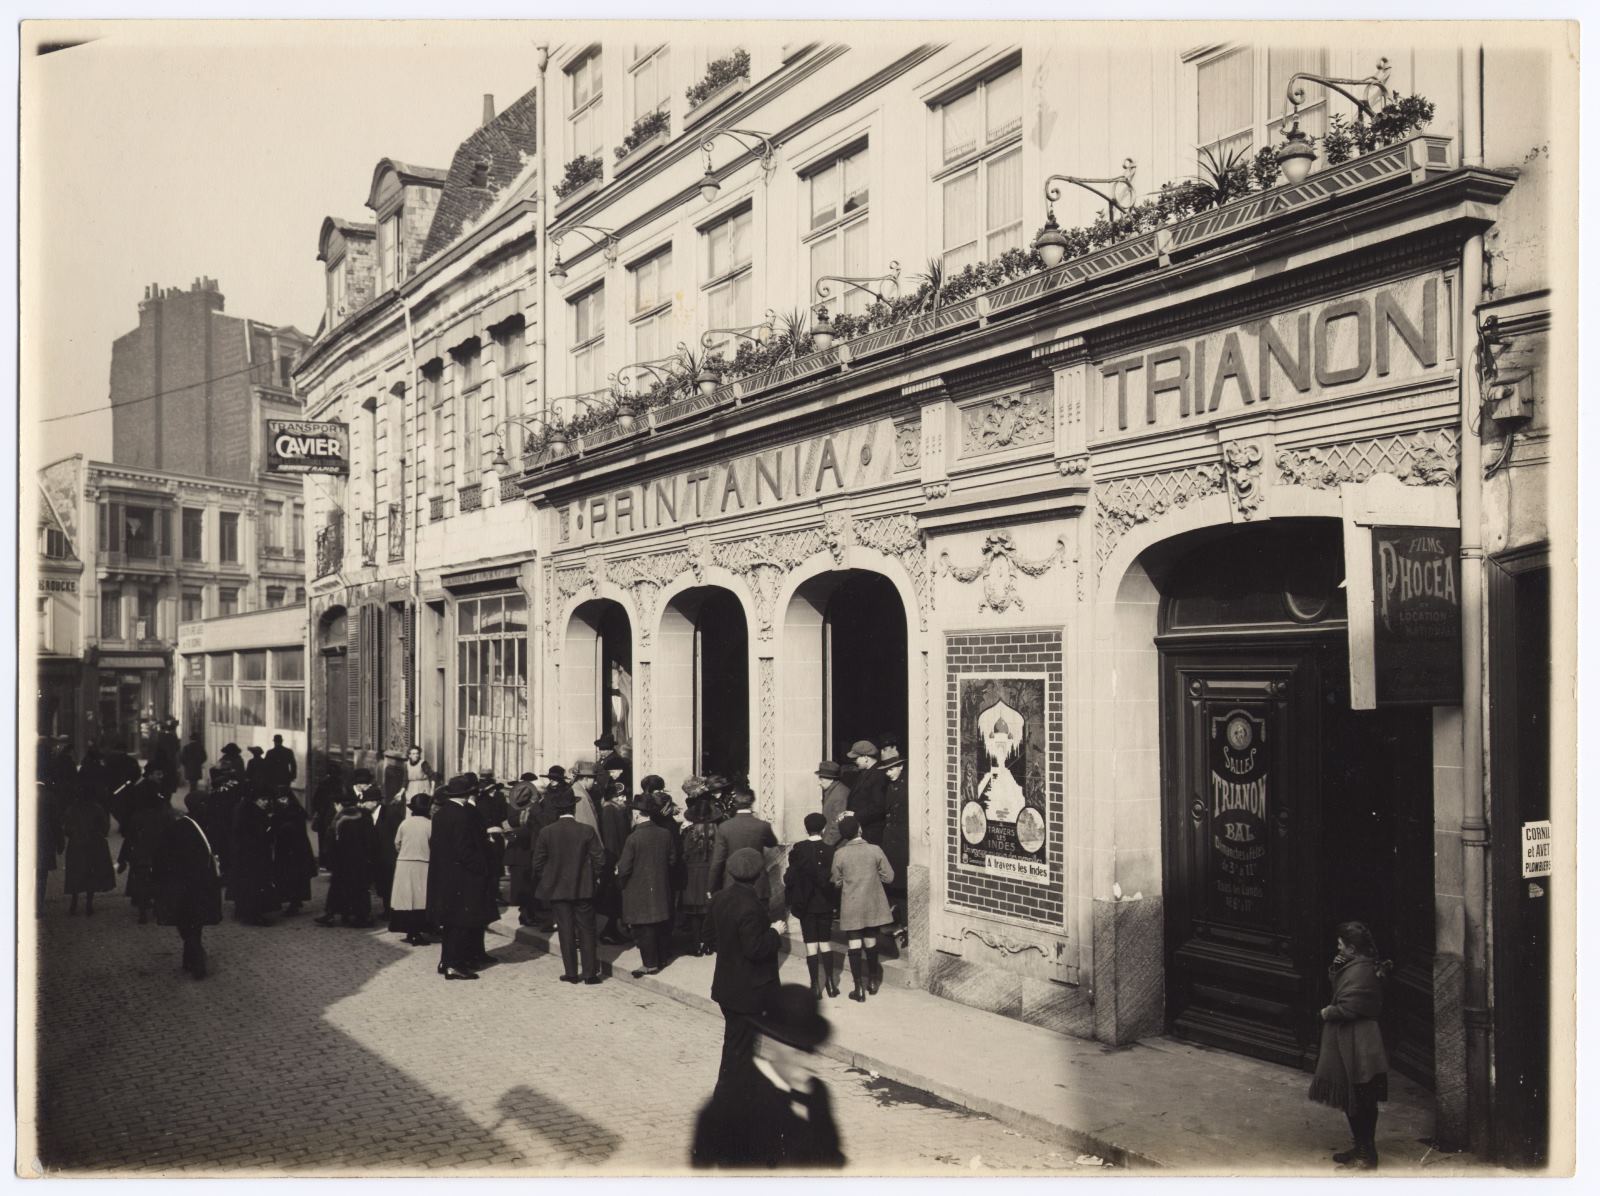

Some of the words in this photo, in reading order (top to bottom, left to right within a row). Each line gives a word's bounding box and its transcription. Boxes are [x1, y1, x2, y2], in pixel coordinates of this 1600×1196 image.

[1103, 278, 1438, 431] TRIANON
[275, 435, 342, 458] CAVIER
[590, 437, 844, 539] PRINTANIA
[1408, 536, 1446, 555] FILMS
[1223, 745, 1257, 775] SALLES
[1212, 769, 1267, 823] TRIANON
[987, 826, 1015, 837] TRAVERS
[1225, 822, 1256, 842] BAL
[988, 840, 1016, 852] INDES
[1527, 845, 1535, 858] et
[1017, 863, 1028, 874] les
[1029, 865, 1048, 877] Indes
